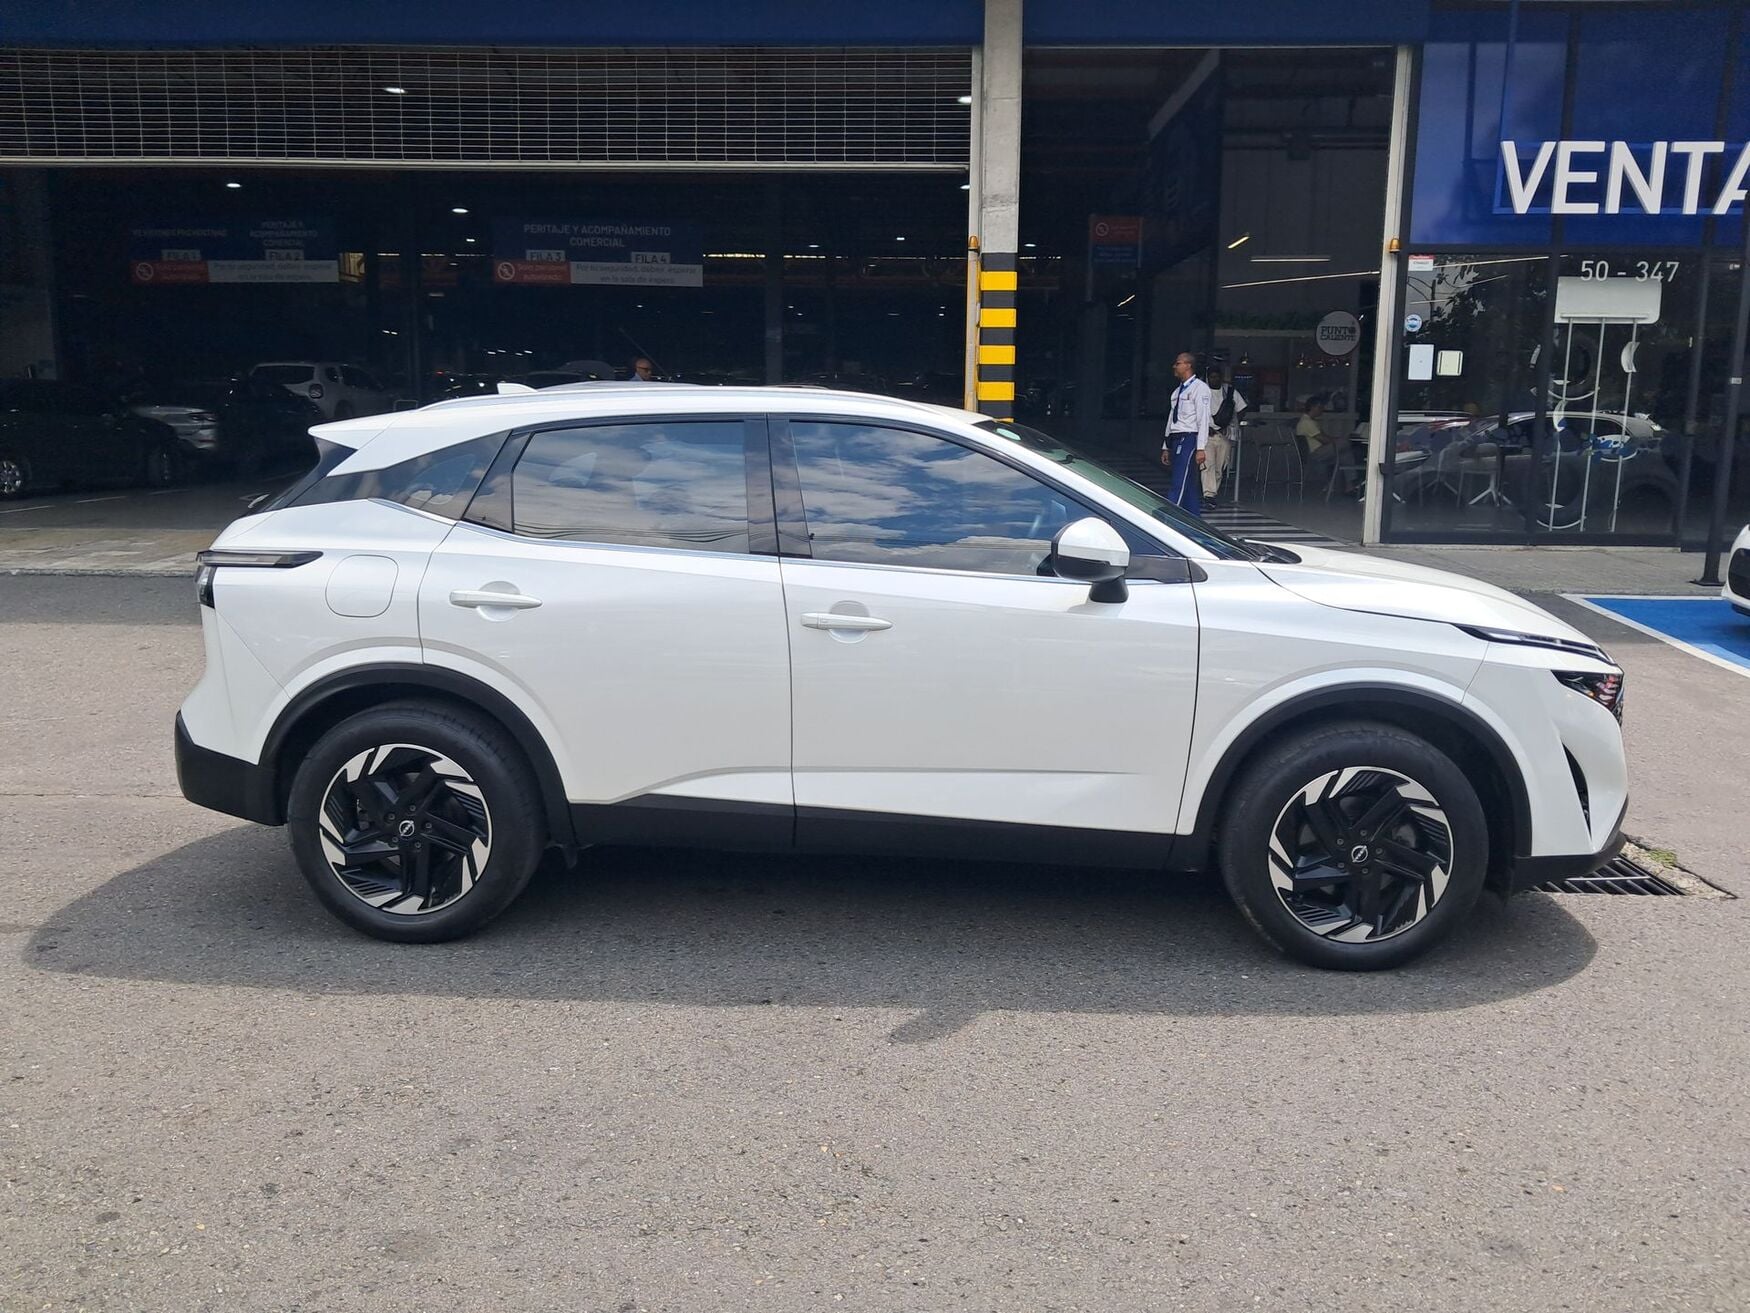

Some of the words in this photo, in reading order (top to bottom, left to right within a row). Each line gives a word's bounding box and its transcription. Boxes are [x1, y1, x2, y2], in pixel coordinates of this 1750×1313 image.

[523, 223, 571, 234] PERITAJE
[572, 224, 580, 234] Y
[580, 223, 671, 236] ACOMPAÑAMIENTO
[569, 236, 625, 248] COMERCIAL
[529, 250, 553, 262] FILA
[635, 253, 660, 264] FILA
[660, 254, 667, 264] 4
[1580, 259, 1609, 282] 50
[1635, 260, 1680, 282] 347
